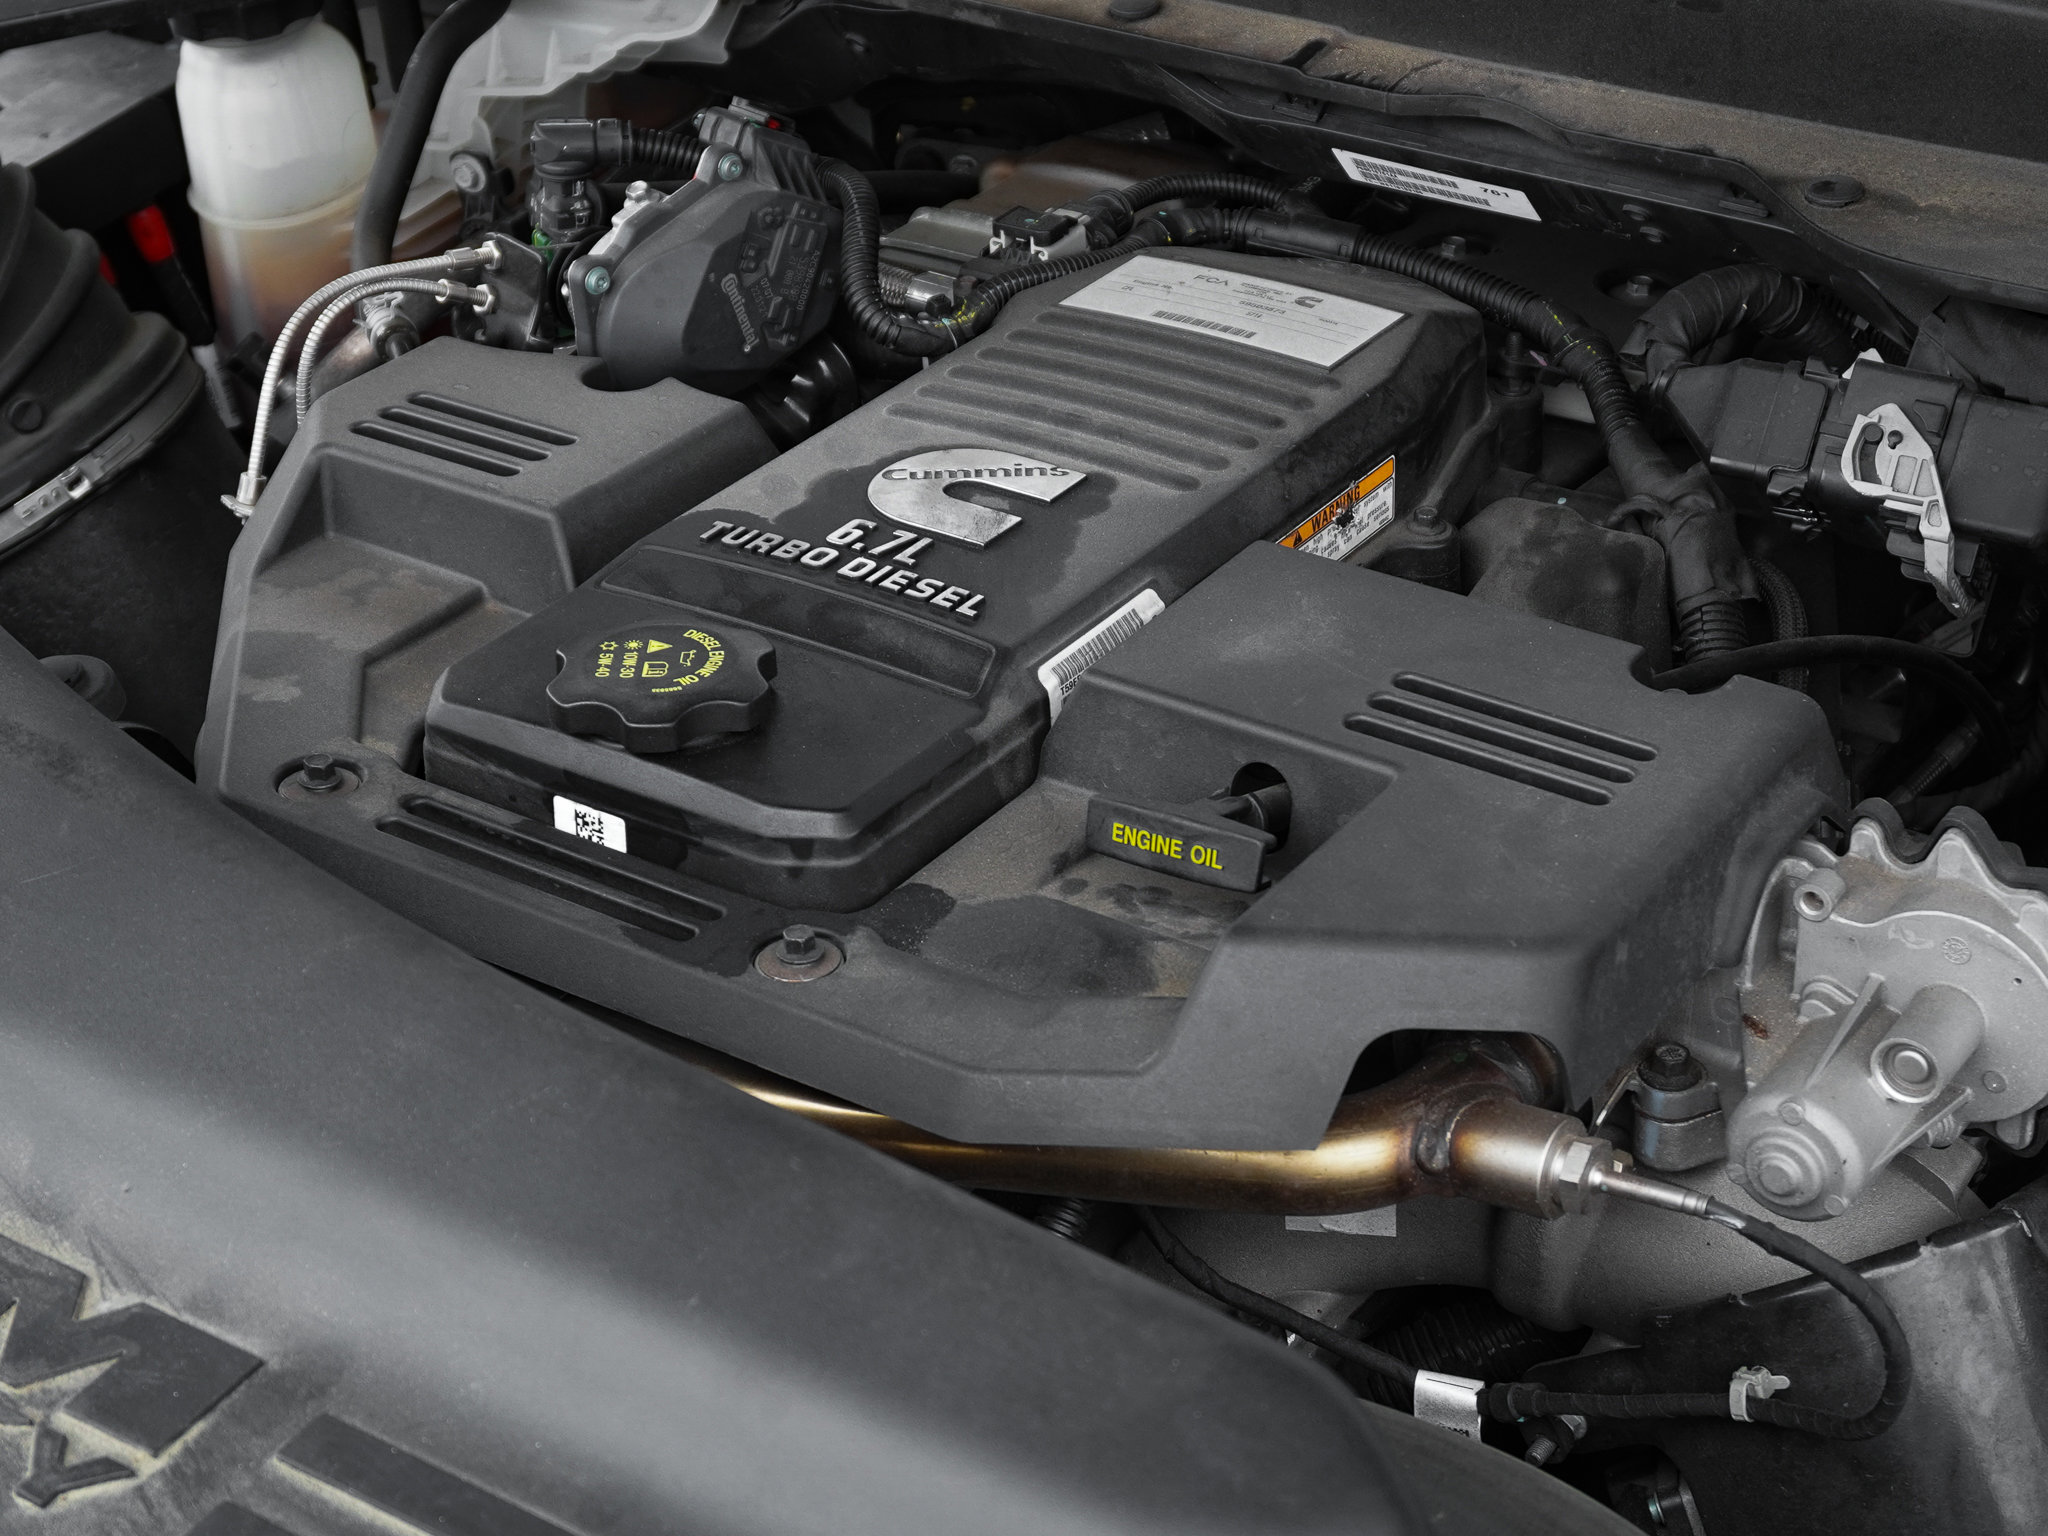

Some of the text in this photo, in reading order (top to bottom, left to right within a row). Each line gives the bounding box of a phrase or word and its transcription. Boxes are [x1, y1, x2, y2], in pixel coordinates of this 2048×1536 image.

[1479, 186, 1510, 198] 761
[1193, 274, 1229, 286] FCA
[720, 273, 759, 347] Continental
[881, 463, 1071, 481] Cummins
[826, 518, 934, 567] 6.7L
[699, 520, 986, 620] TURBO DIESEL
[595, 652, 614, 678] 5W-40
[619, 651, 638, 679] 10W-30
[673, 629, 725, 686] DIESEL ENGINE OIL
[1111, 822, 1223, 870] ENGINE OIL
